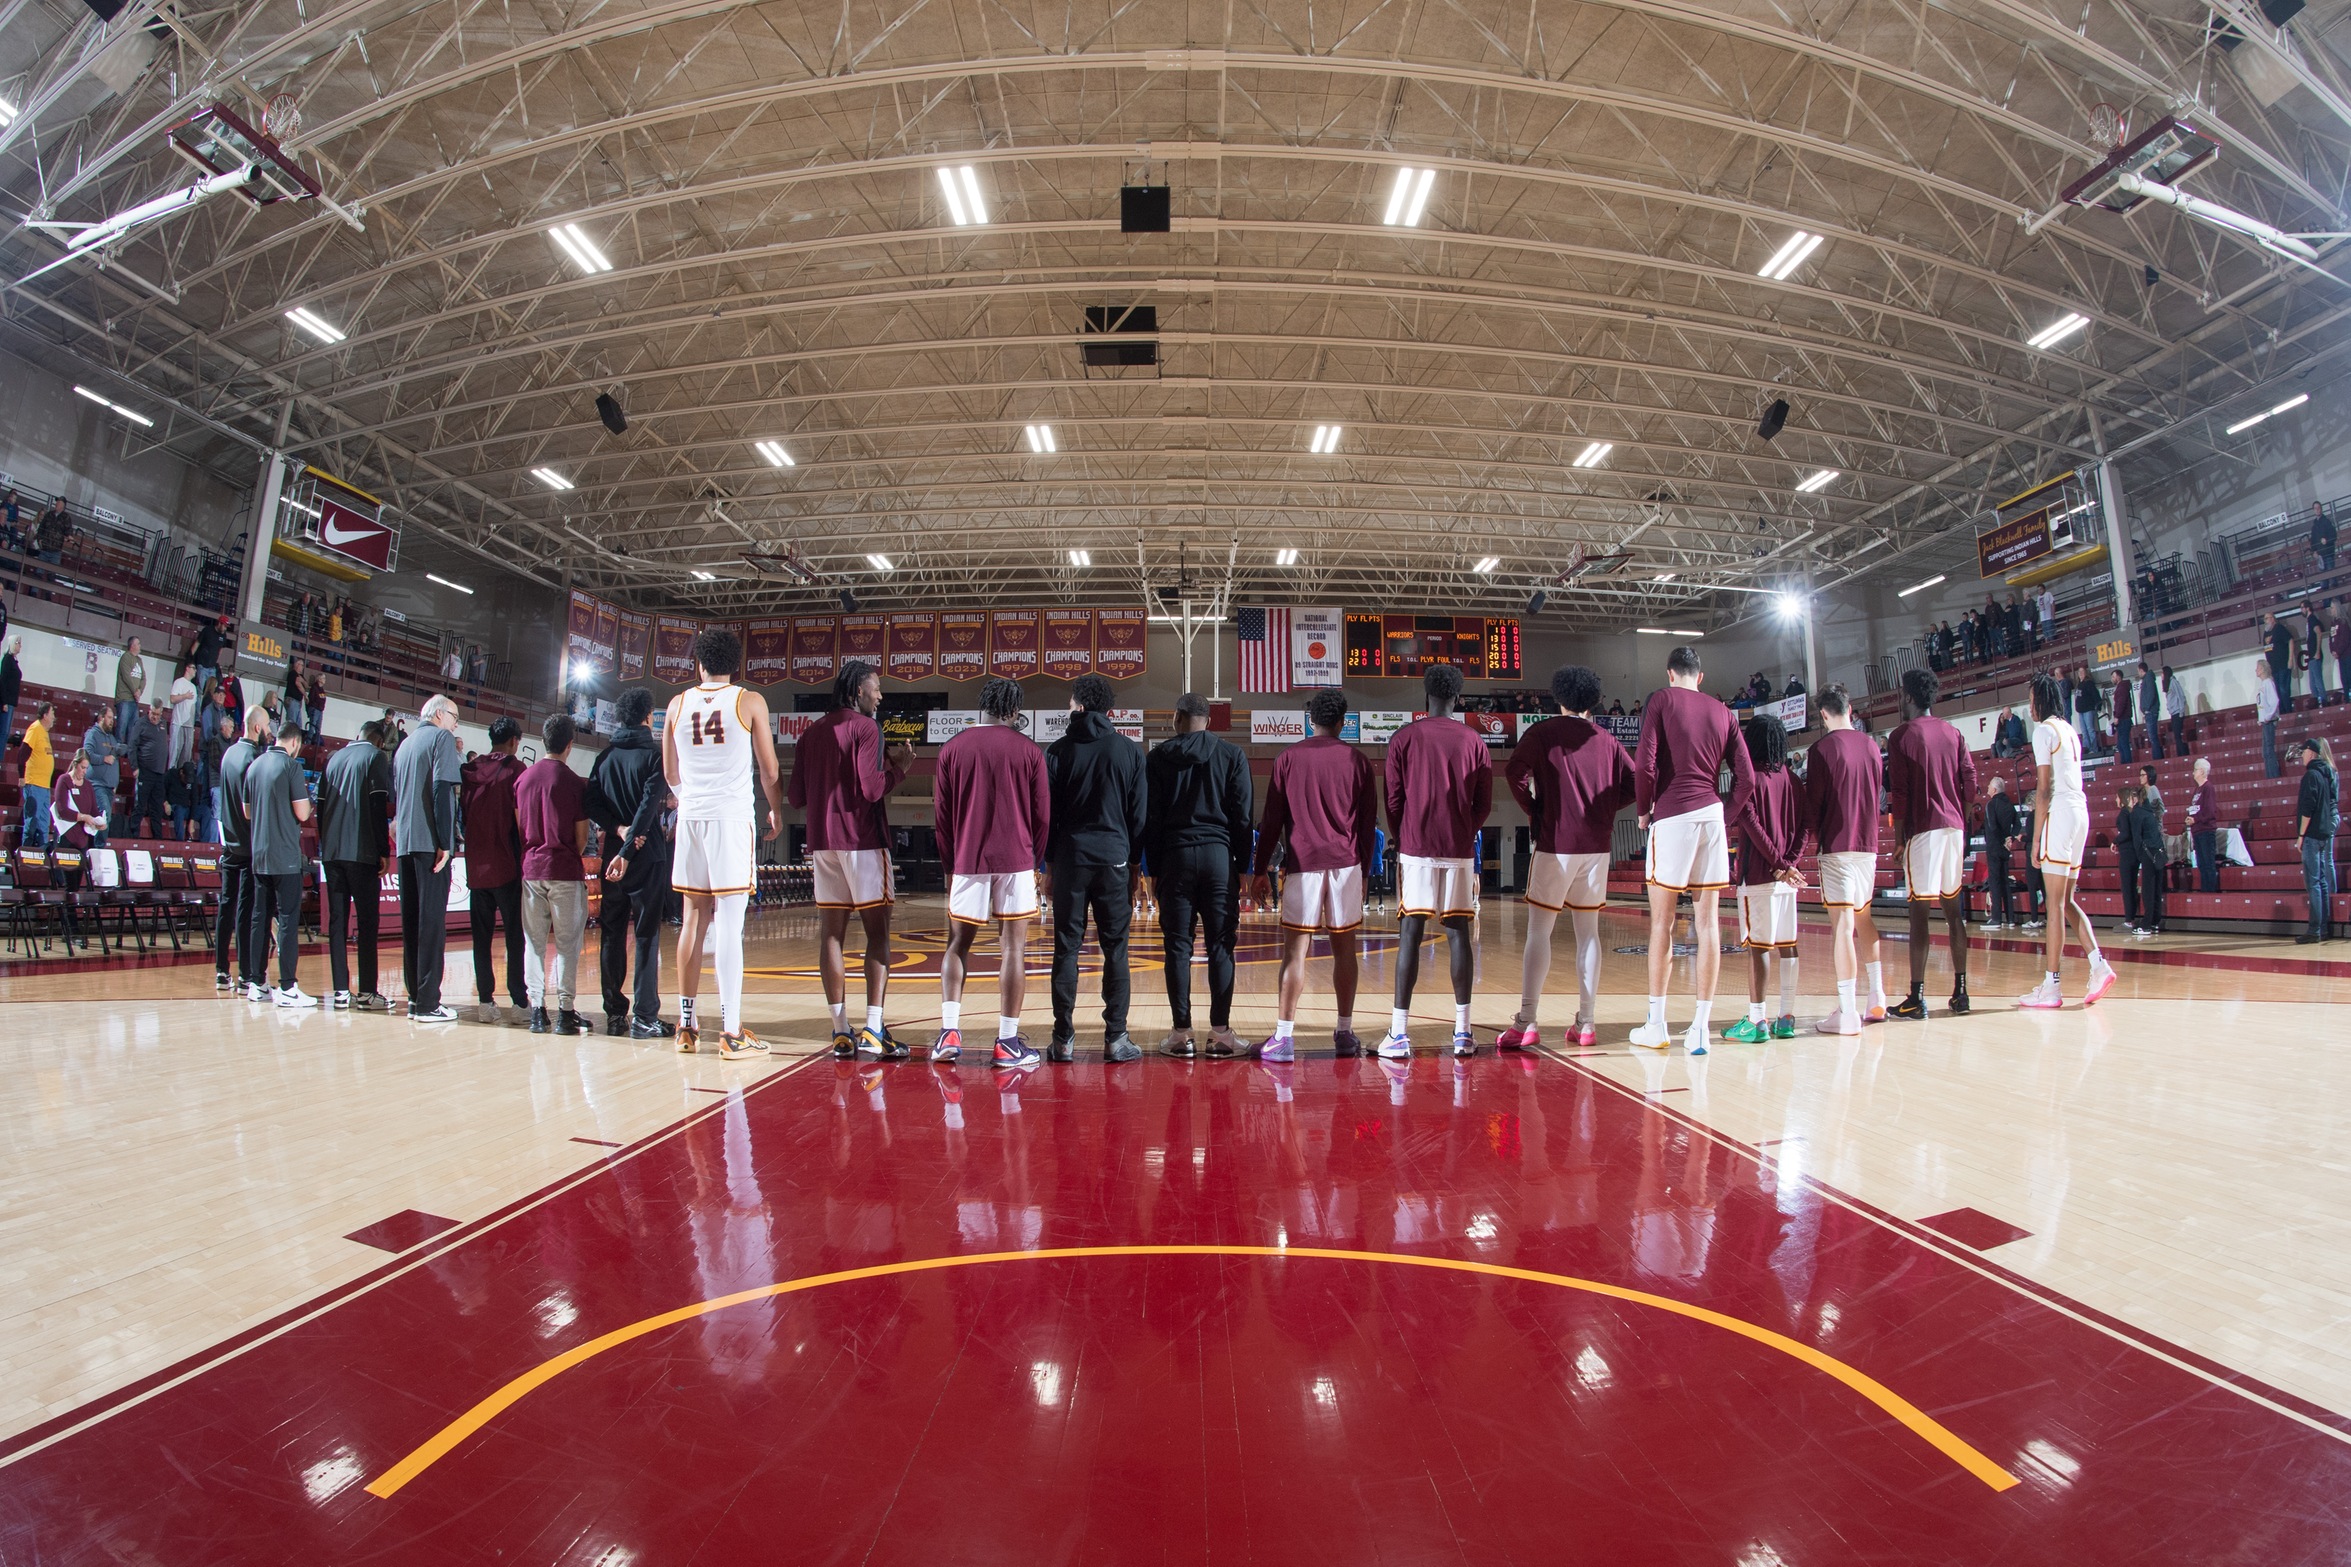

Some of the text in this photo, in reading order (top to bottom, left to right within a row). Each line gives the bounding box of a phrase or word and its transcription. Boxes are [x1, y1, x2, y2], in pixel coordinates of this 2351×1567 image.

[96, 508, 118, 520] BALCONY
[2258, 517, 2279, 530] BALCONY
[1988, 535, 2042, 562] SUPPORTING INDIAN HILLS
[2004, 554, 2017, 564] SINCE
[2093, 575, 2111, 585] BALCONY
[386, 610, 401, 619] BALCONY
[633, 614, 650, 626] HILLS
[843, 616, 883, 625] INDIAN HILLS
[892, 614, 934, 623] INDIAN HILLS
[942, 614, 985, 623] INDIAN HILLS
[994, 612, 1037, 620] INDIAN HILLS
[1046, 611, 1090, 619] INDIAN HILLS
[1099, 611, 1143, 619] INDIAN HILLS
[660, 618, 697, 629] INDIAN HILLS
[770, 620, 788, 628] HILLS
[818, 618, 835, 626] HILLS
[97, 645, 122, 657] SEATING
[248, 633, 282, 658] Hills
[2096, 640, 2133, 662] Hills
[993, 651, 1036, 664] CHAMPIONS
[1046, 651, 1090, 663] CHAMPIONS
[1099, 650, 1143, 663] CHAMPIONS
[1351, 649, 1380, 657] 13 0 0
[1502, 652, 1507, 660] 0
[1514, 652, 1519, 660] 0
[85, 652, 98, 673] B
[238, 652, 257, 662] Download
[274, 661, 288, 669] Today!
[656, 656, 695, 670] CHAMPIONS
[748, 658, 786, 670] CHAMPIONS
[793, 656, 832, 669] CHAMPIONS
[890, 653, 932, 666] CHAMPIONS
[941, 653, 983, 666] CHAMPIONS
[1348, 658, 1380, 666] 22 0 0
[1514, 661, 1519, 669] 0
[2298, 651, 2309, 671] G
[660, 668, 689, 677] 2000
[1001, 664, 1028, 672] 1997
[2090, 664, 2110, 673] Download
[691, 710, 725, 746] 14
[780, 716, 814, 740] HyVe
[882, 720, 924, 736] Barbecue
[1253, 724, 1302, 733] WINGER
[1610, 718, 1638, 727] TEAM
[1979, 717, 1986, 732] F
[2070, 736, 2077, 762] 1
